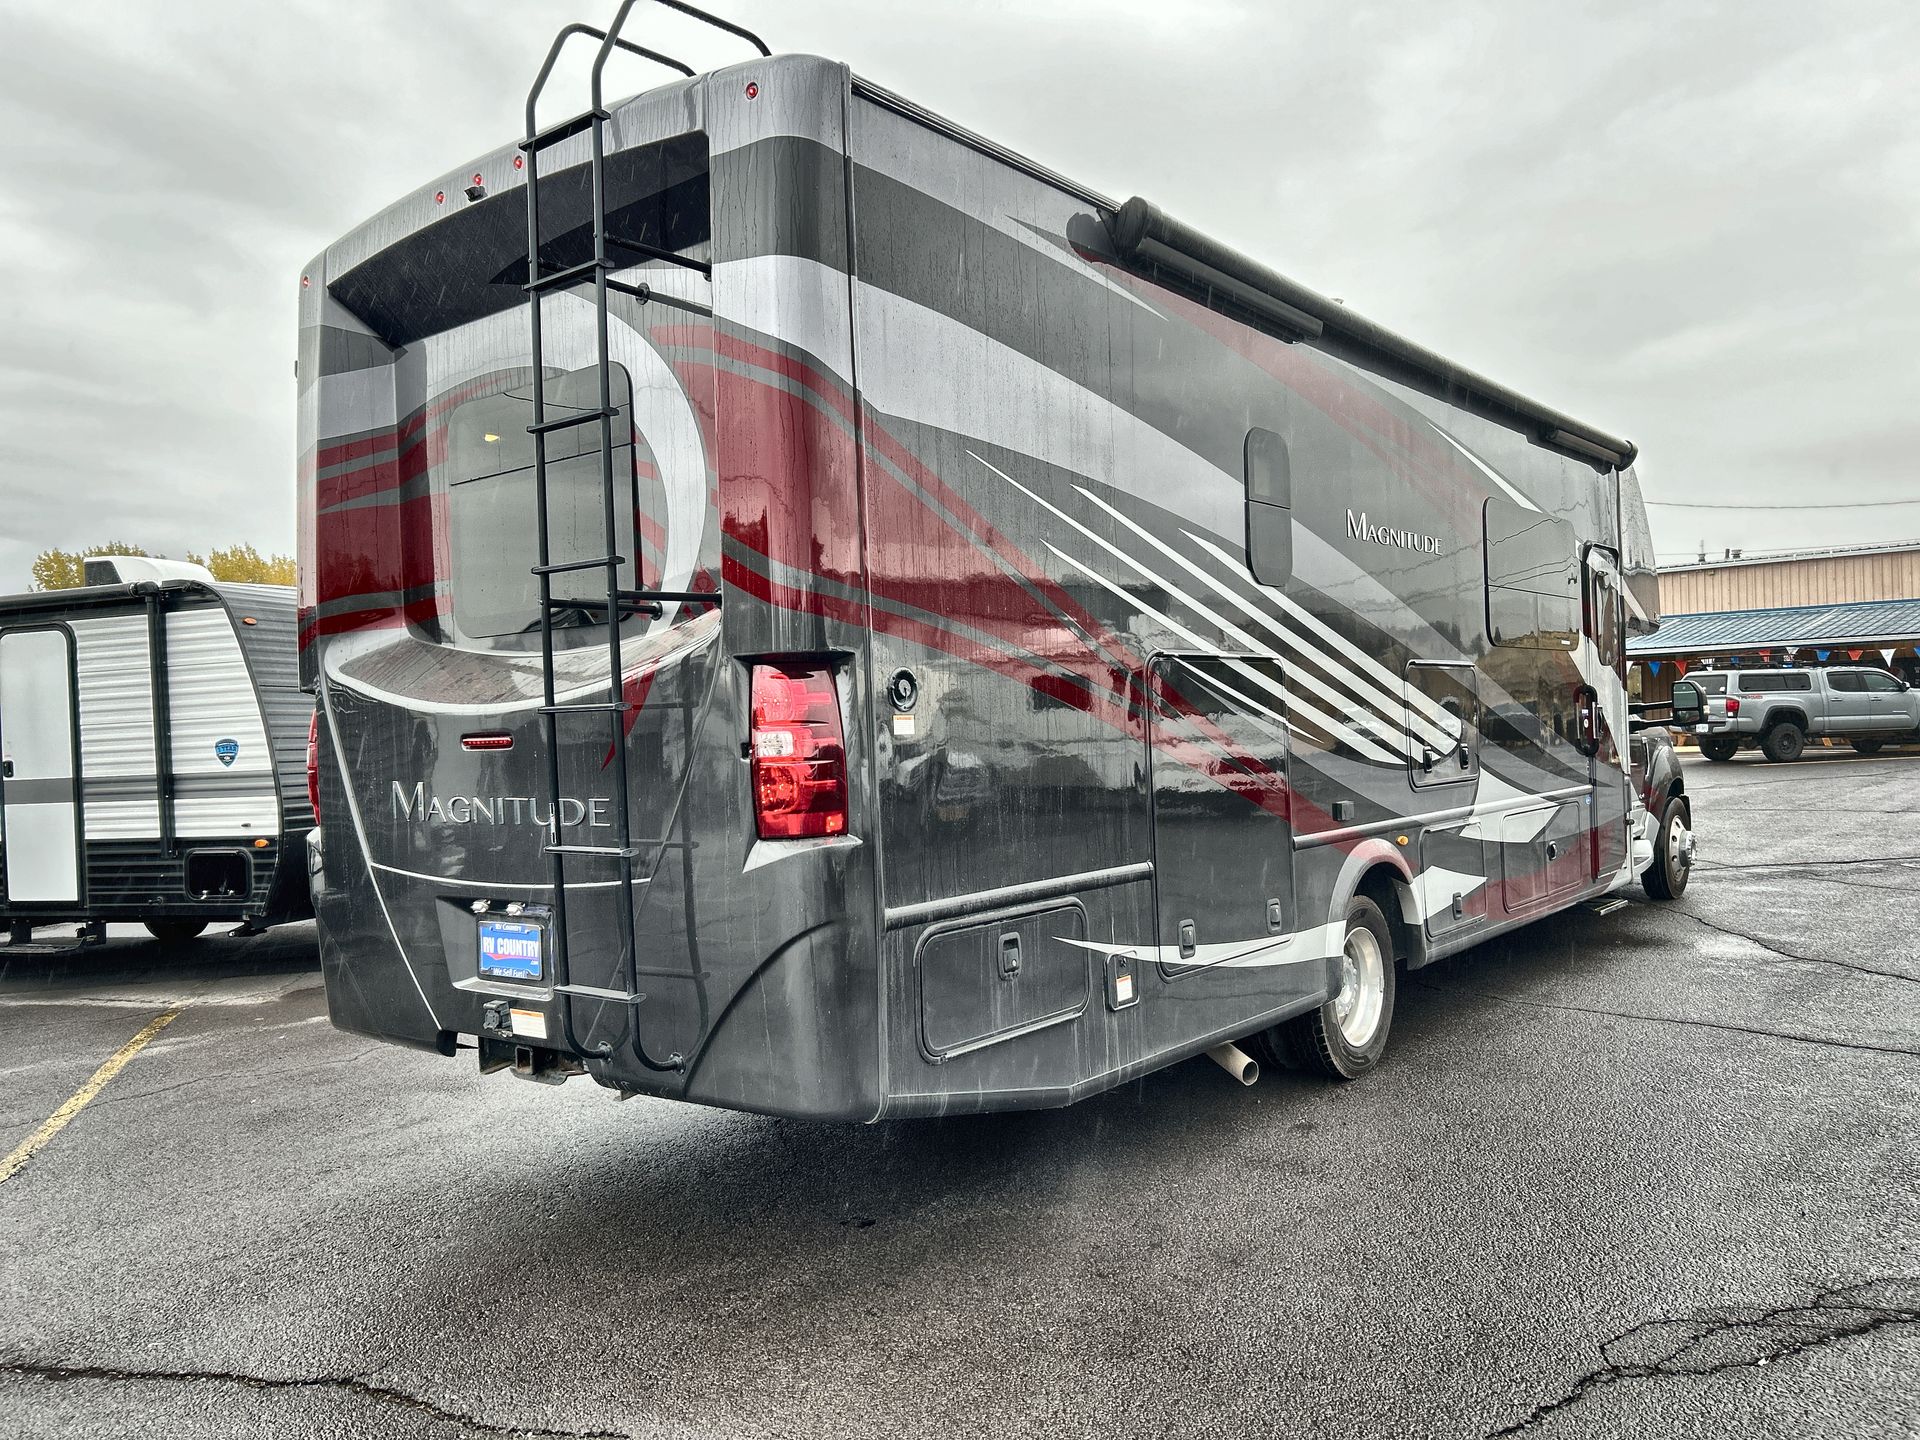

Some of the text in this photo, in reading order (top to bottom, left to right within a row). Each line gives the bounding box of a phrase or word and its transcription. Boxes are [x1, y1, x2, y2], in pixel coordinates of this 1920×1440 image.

[1345, 508, 1442, 556] MAGNITUDE
[392, 780, 611, 827] MAGNITUDE
[483, 936, 539, 957] RV COUNTRY
